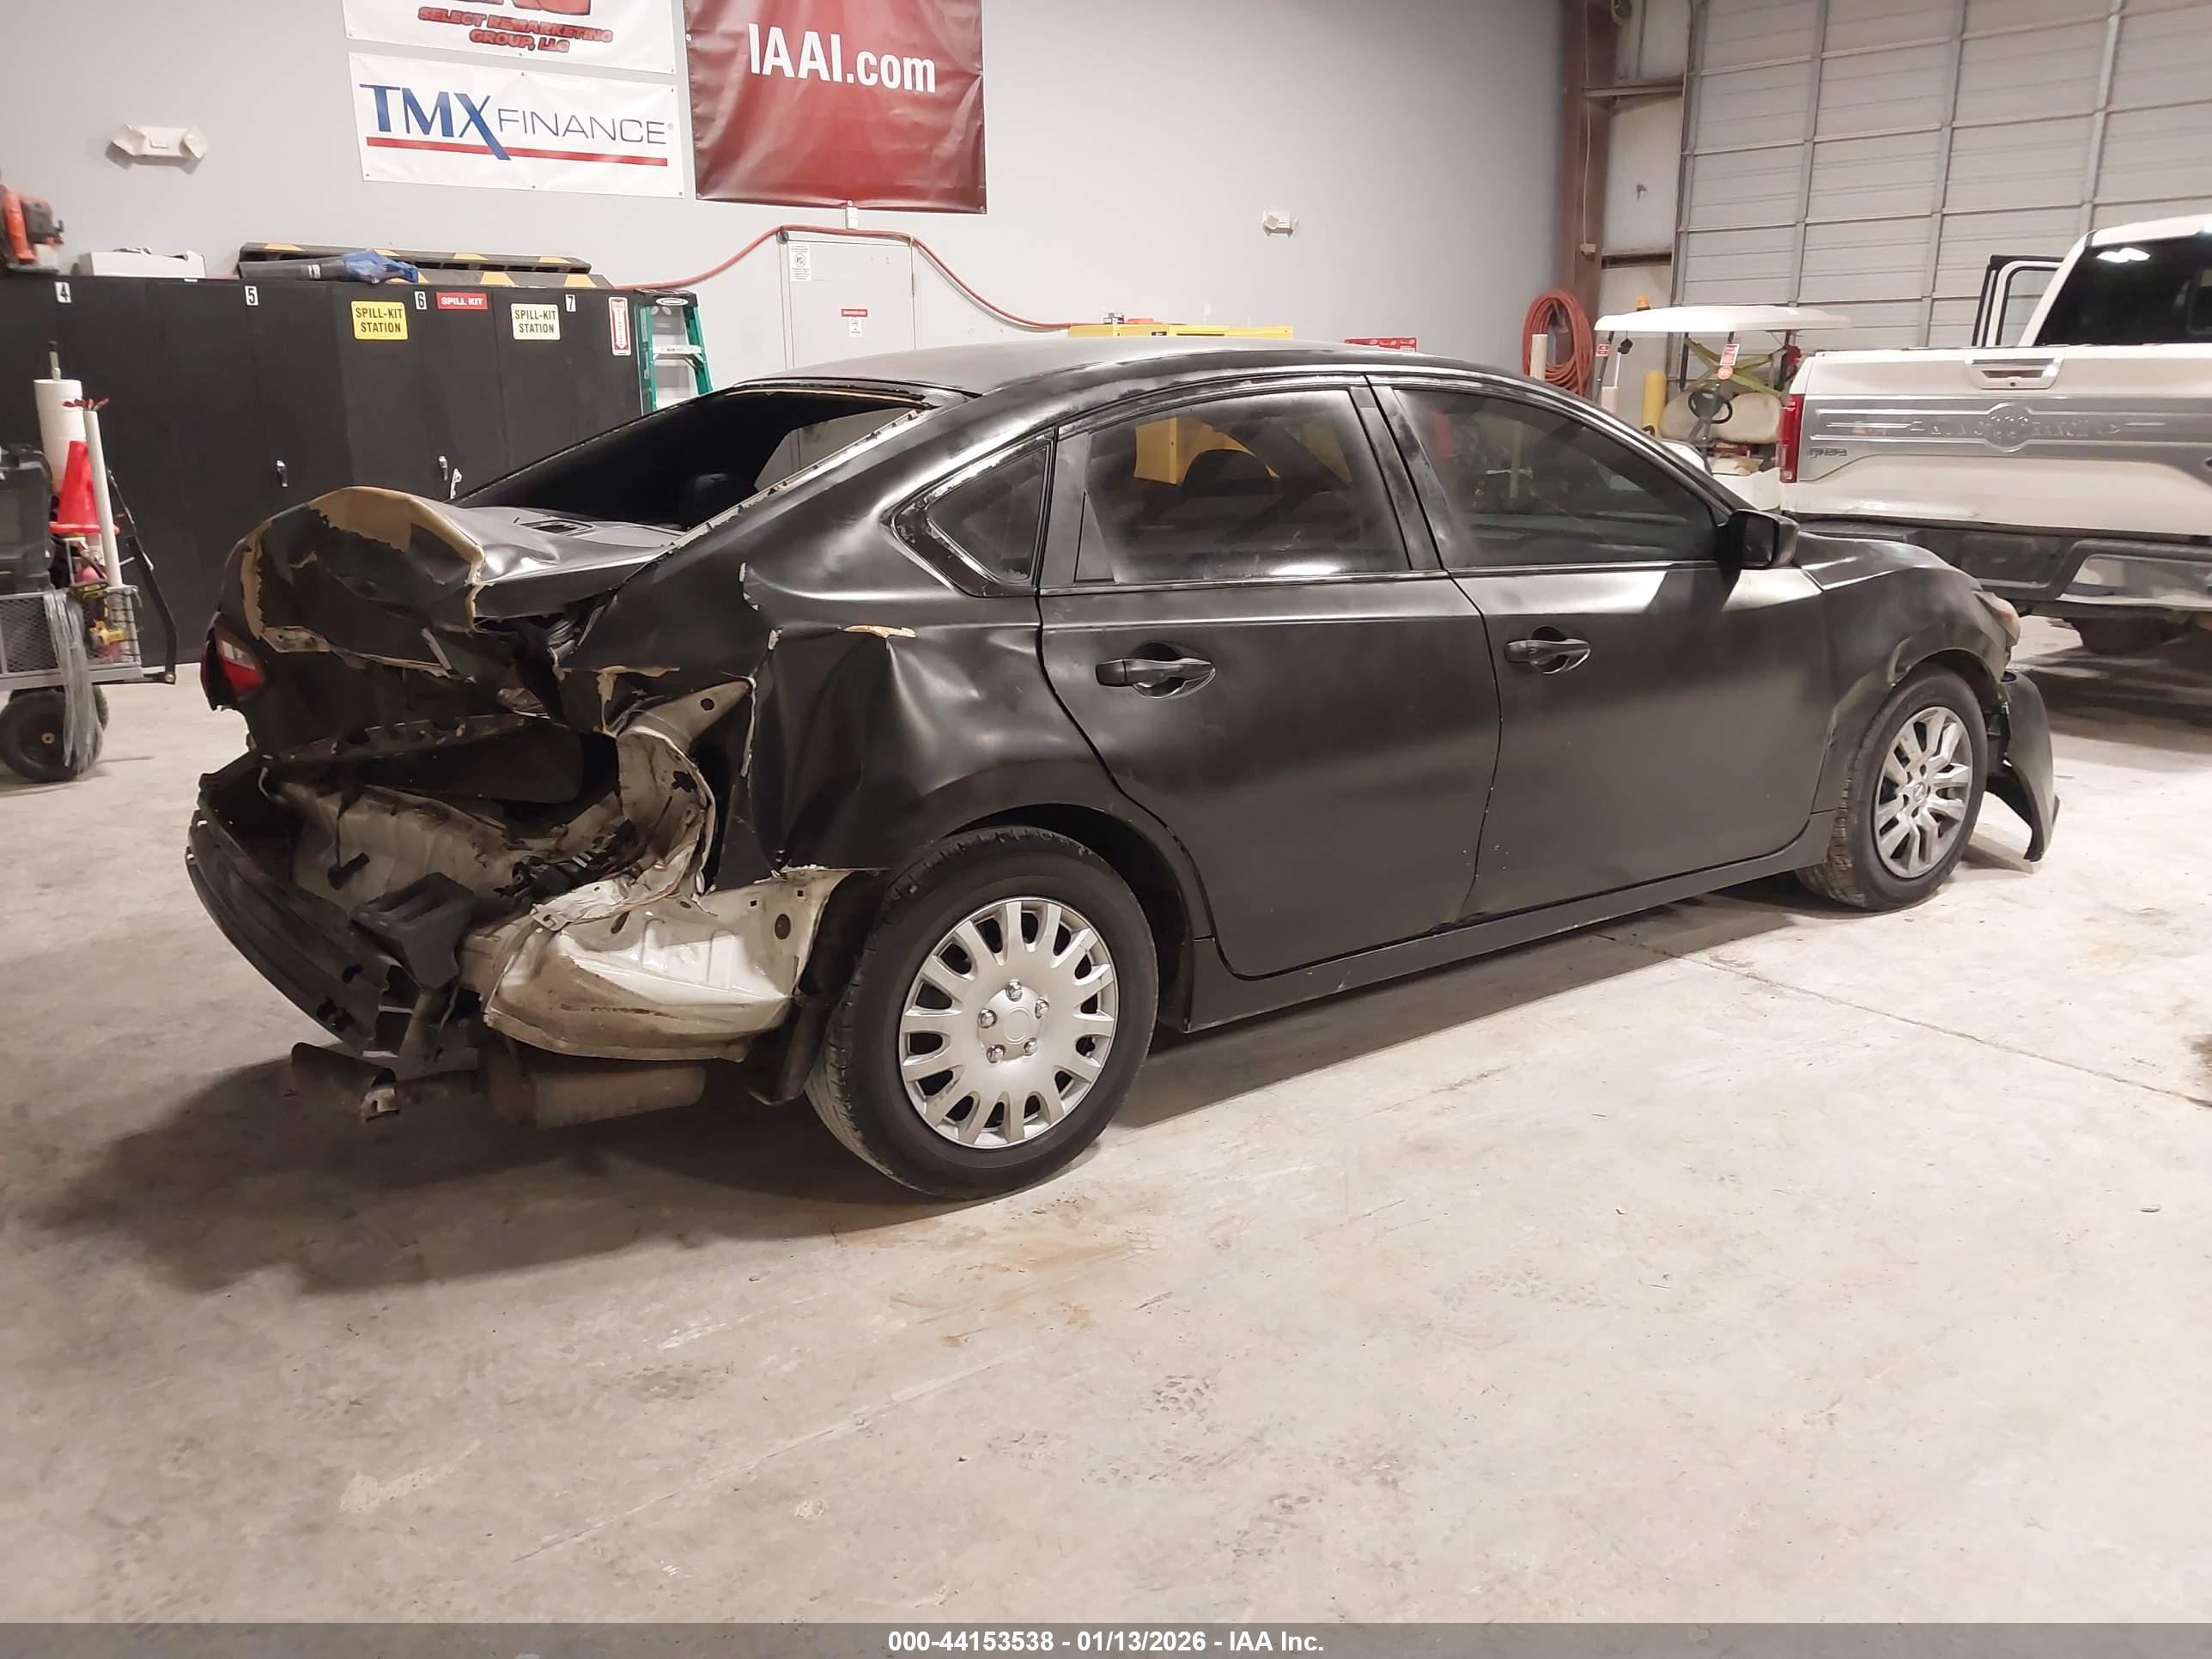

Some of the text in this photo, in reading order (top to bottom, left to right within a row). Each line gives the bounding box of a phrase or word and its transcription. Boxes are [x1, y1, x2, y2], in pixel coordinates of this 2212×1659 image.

[417, 7, 487, 27] SELECT
[487, 14, 613, 42] REMARKETING
[469, 28, 535, 51] GROUP,
[748, 23, 936, 93] IAAI.com
[60, 283, 69, 301] 4
[248, 288, 255, 304] 5
[417, 293, 425, 308] 6
[441, 296, 483, 306] SPILL KIT
[568, 295, 573, 310] 7
[356, 307, 403, 319] SPILL-KIT
[515, 310, 556, 320] SPILL-KIT
[361, 322, 401, 332] STATION
[520, 324, 555, 333] STATION
